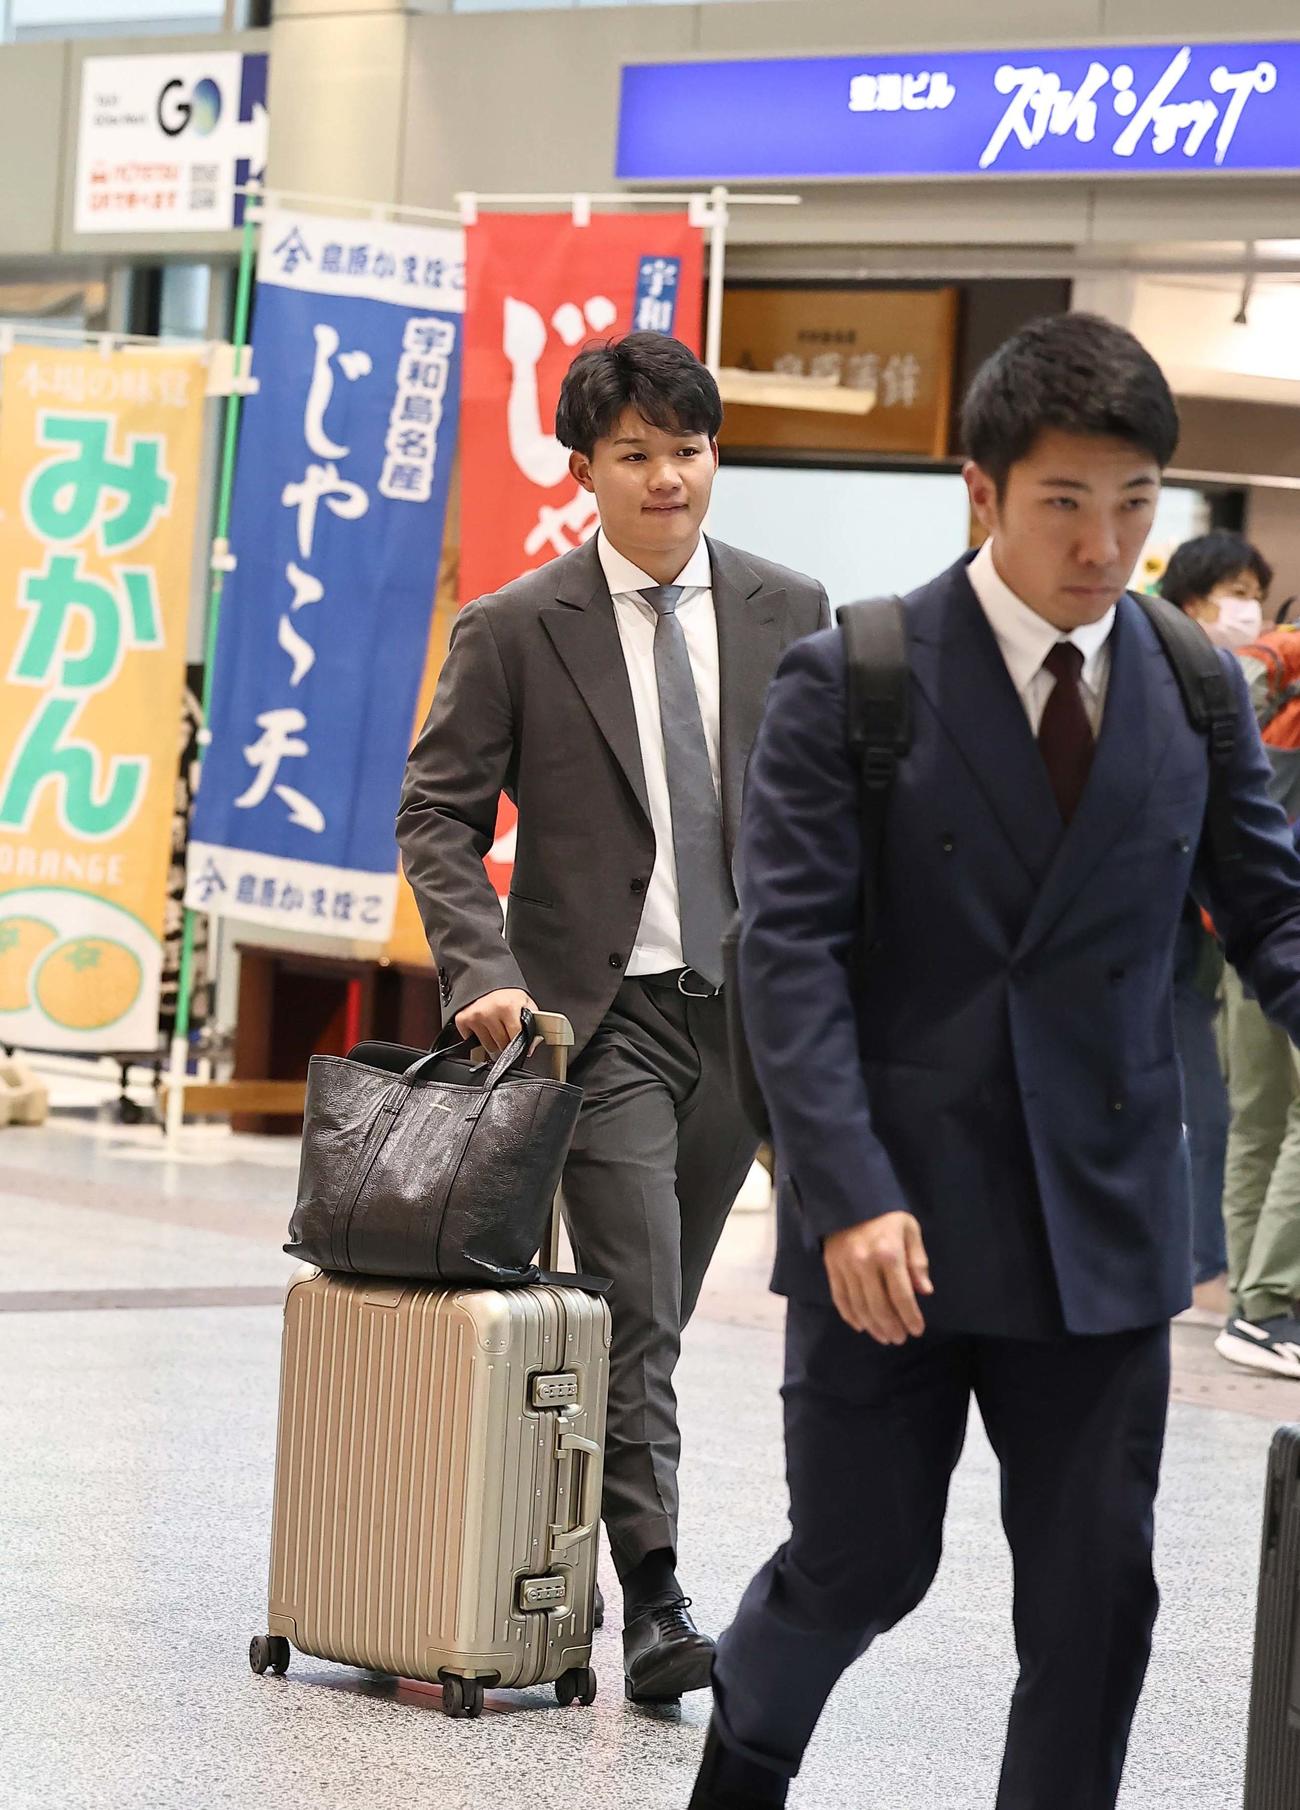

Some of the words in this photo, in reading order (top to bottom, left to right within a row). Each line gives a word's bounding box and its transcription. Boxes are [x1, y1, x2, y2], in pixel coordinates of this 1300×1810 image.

[156, 77, 222, 137] GO
[0, 410, 175, 843] みかん
